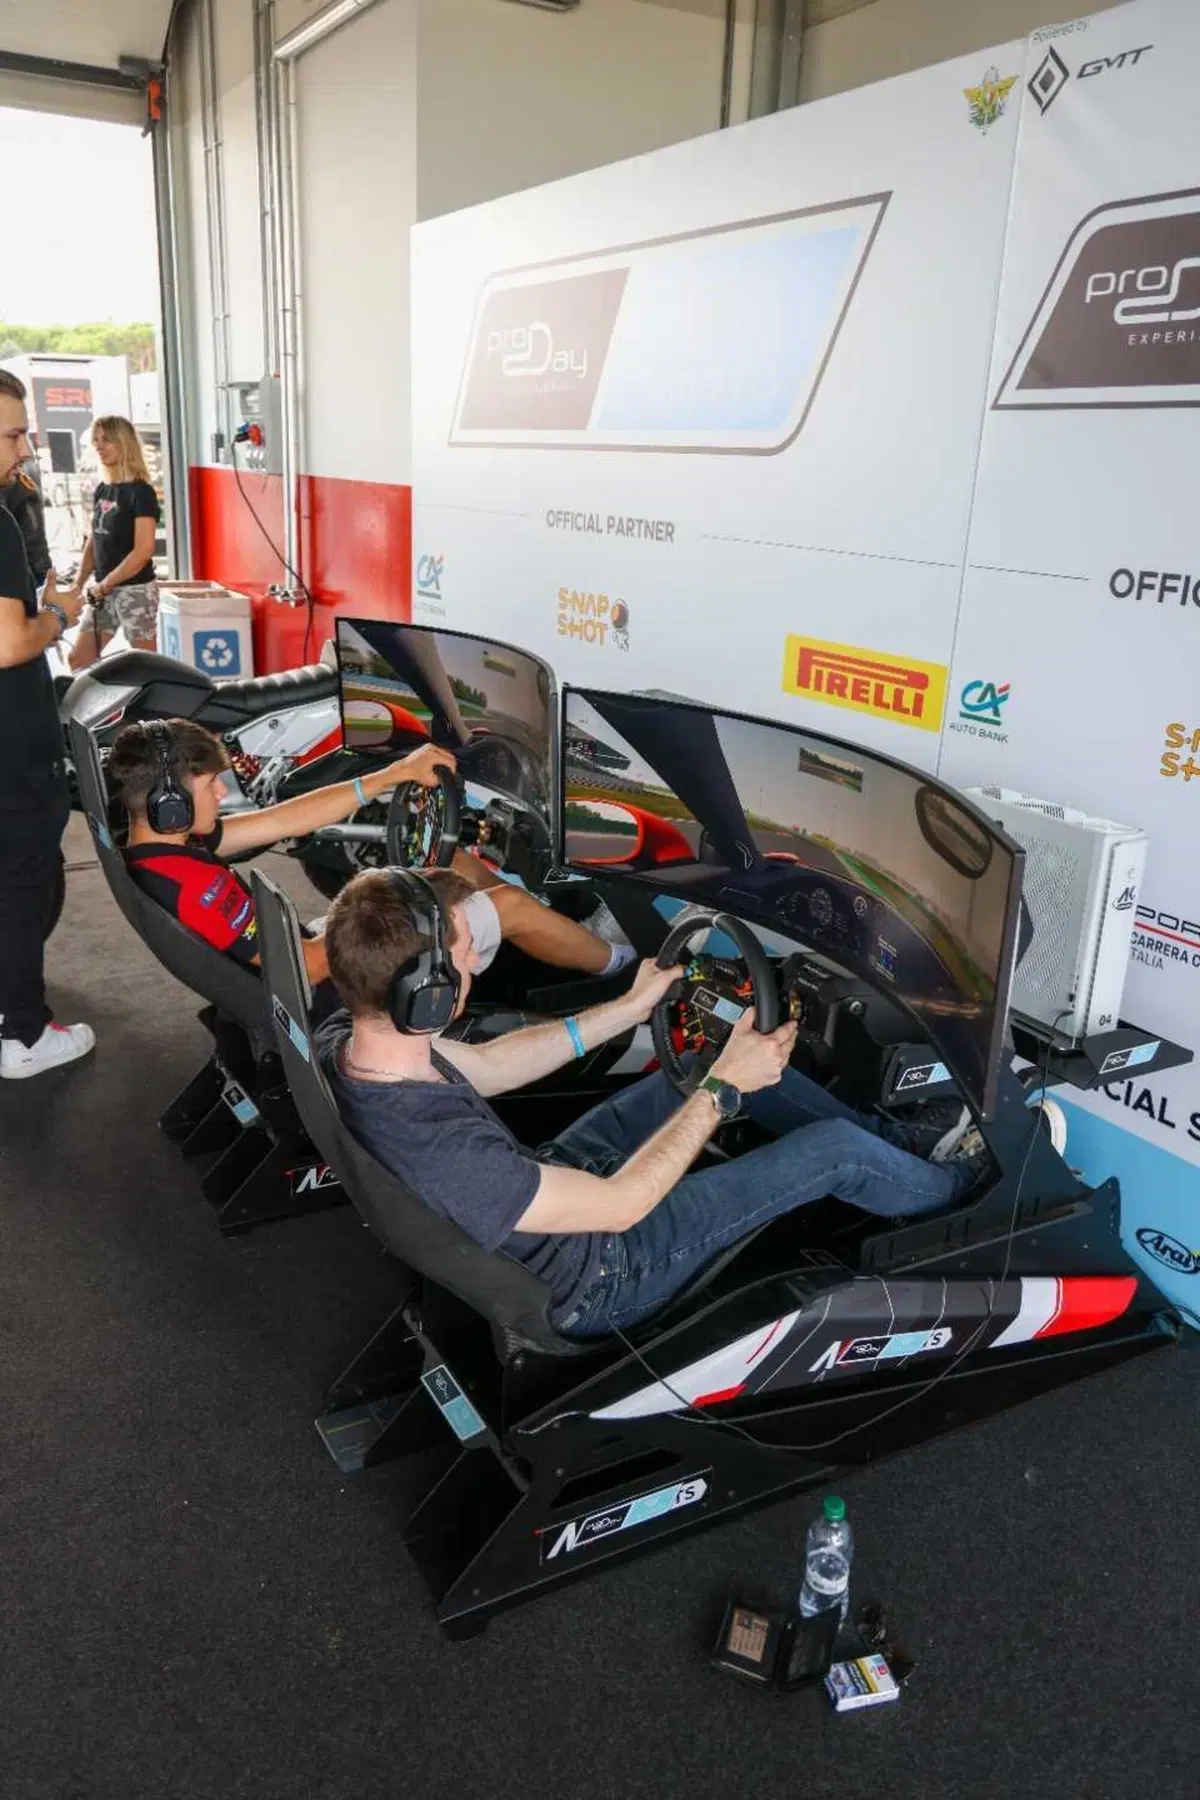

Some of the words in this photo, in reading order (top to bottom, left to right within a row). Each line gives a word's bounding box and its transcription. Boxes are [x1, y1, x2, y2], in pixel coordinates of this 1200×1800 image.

[1077, 45, 1154, 79] GMT
[1128, 330, 1200, 346] EXPERI
[546, 509, 604, 534] OFFICIAL
[606, 515, 676, 543] PARTNER
[797, 646, 929, 719] PIRELLI
[949, 722, 977, 735] AUTO
[979, 728, 1009, 744] BANK
[1130, 931, 1188, 964] CARRERA
[1130, 946, 1164, 970] TALIA
[1099, 1014, 1113, 1027] 04
